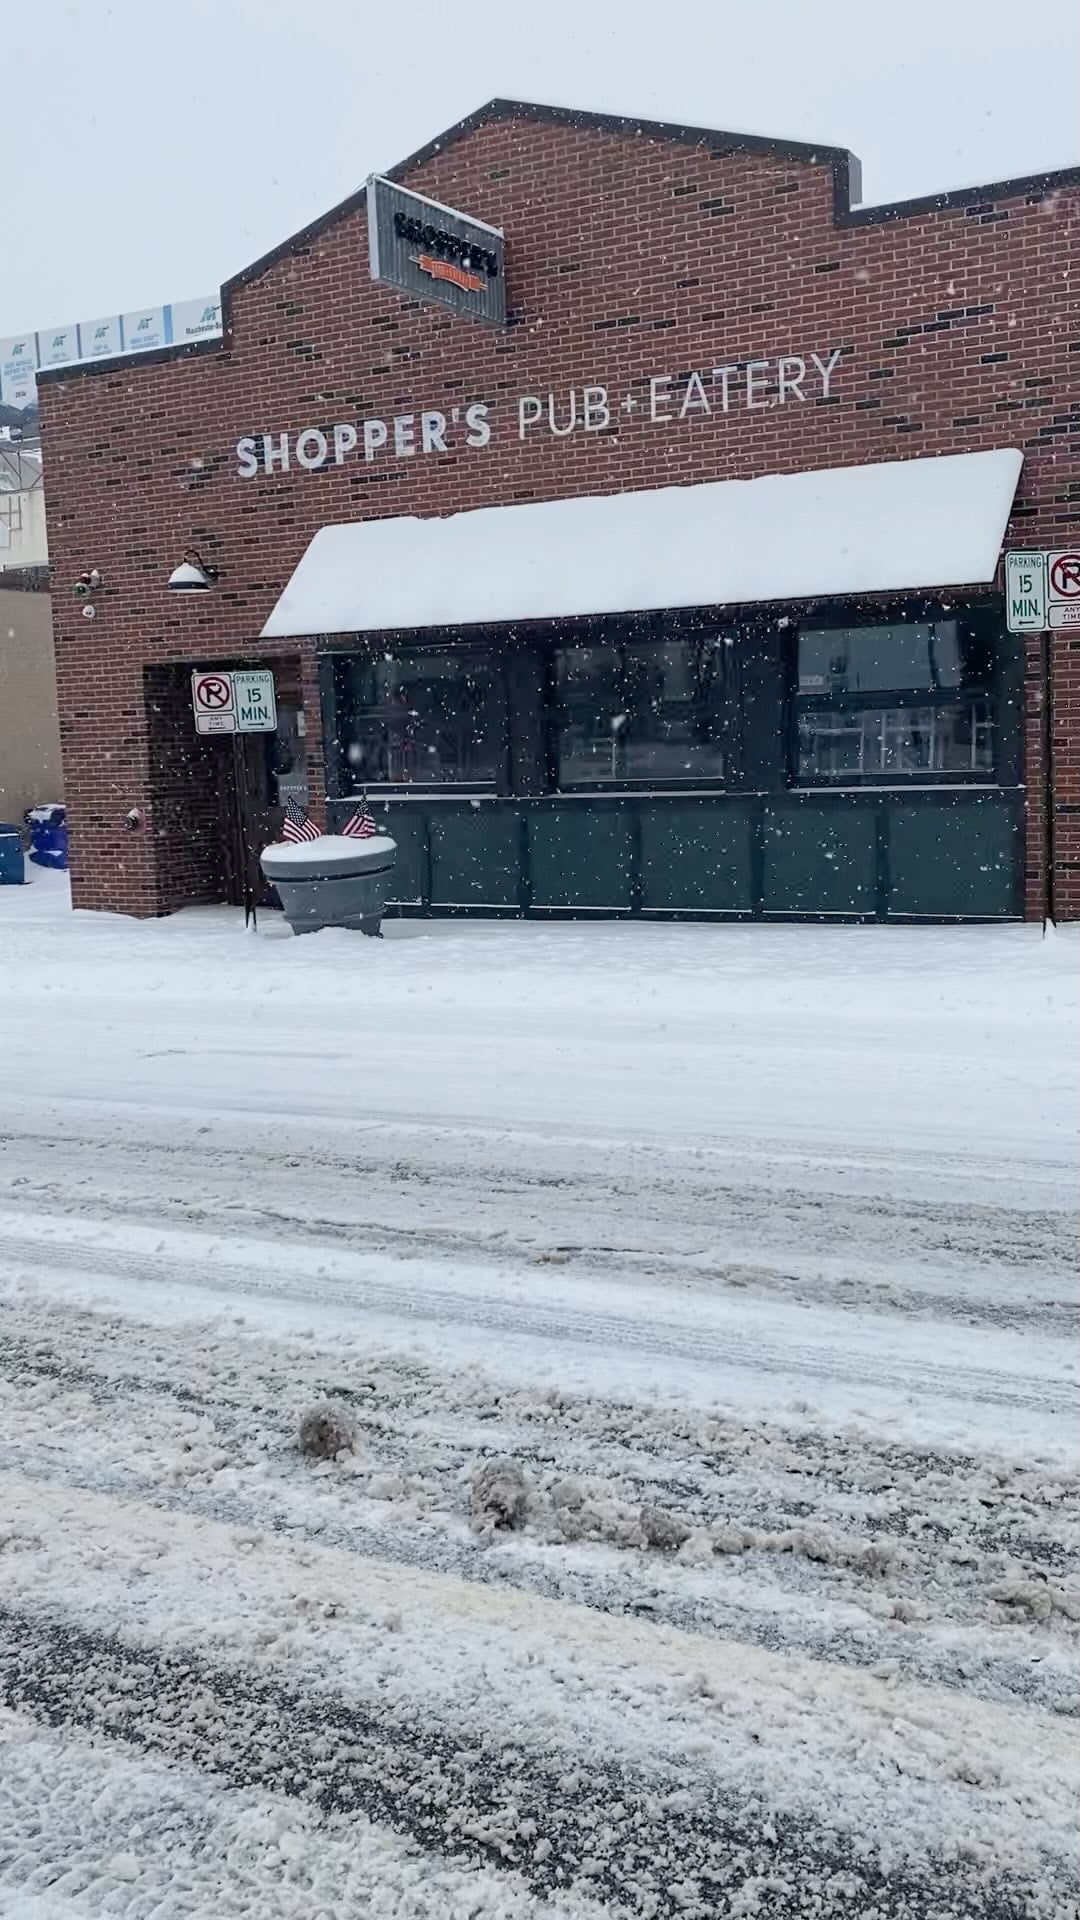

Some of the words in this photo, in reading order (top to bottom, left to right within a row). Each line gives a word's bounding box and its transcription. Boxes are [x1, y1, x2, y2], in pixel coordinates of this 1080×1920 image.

[236, 403, 491, 478] SHOPPER'S
[518, 386, 610, 440] PUB
[649, 349, 841, 422] EATERY
[1009, 556, 1042, 568] PARKING
[1019, 574, 1032, 593] 15
[1012, 599, 1041, 617] MIN.
[236, 675, 270, 684] PARKING
[247, 688, 262, 703] 15
[241, 706, 271, 720] MIN.
